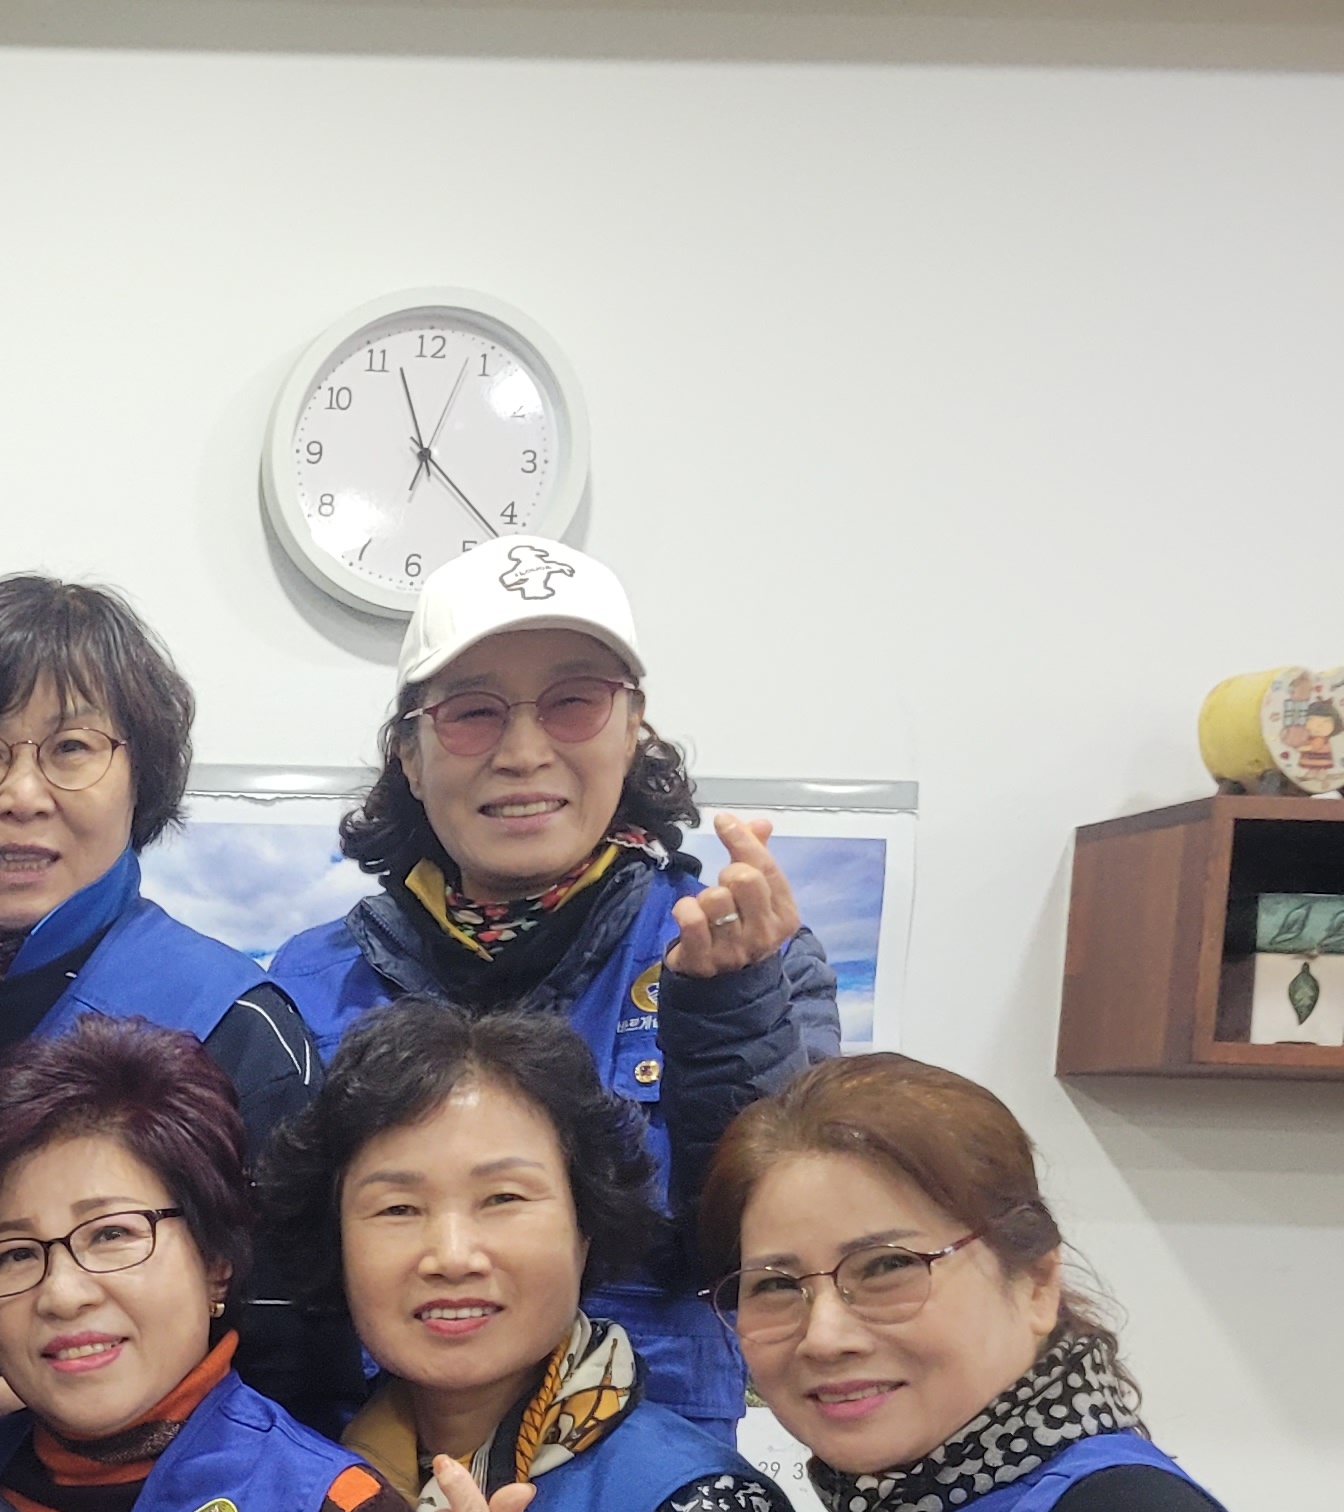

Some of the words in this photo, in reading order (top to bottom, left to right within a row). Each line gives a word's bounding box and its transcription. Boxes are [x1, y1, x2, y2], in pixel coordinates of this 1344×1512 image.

[415, 335, 446, 359] 12
[365, 349, 390, 373] 11
[477, 353, 491, 377] 1
[324, 387, 352, 410] 10
[306, 441, 323, 464] 9
[521, 450, 537, 473] 3
[318, 493, 335, 517] 8
[500, 501, 518, 525] 4
[405, 554, 422, 578] 6
